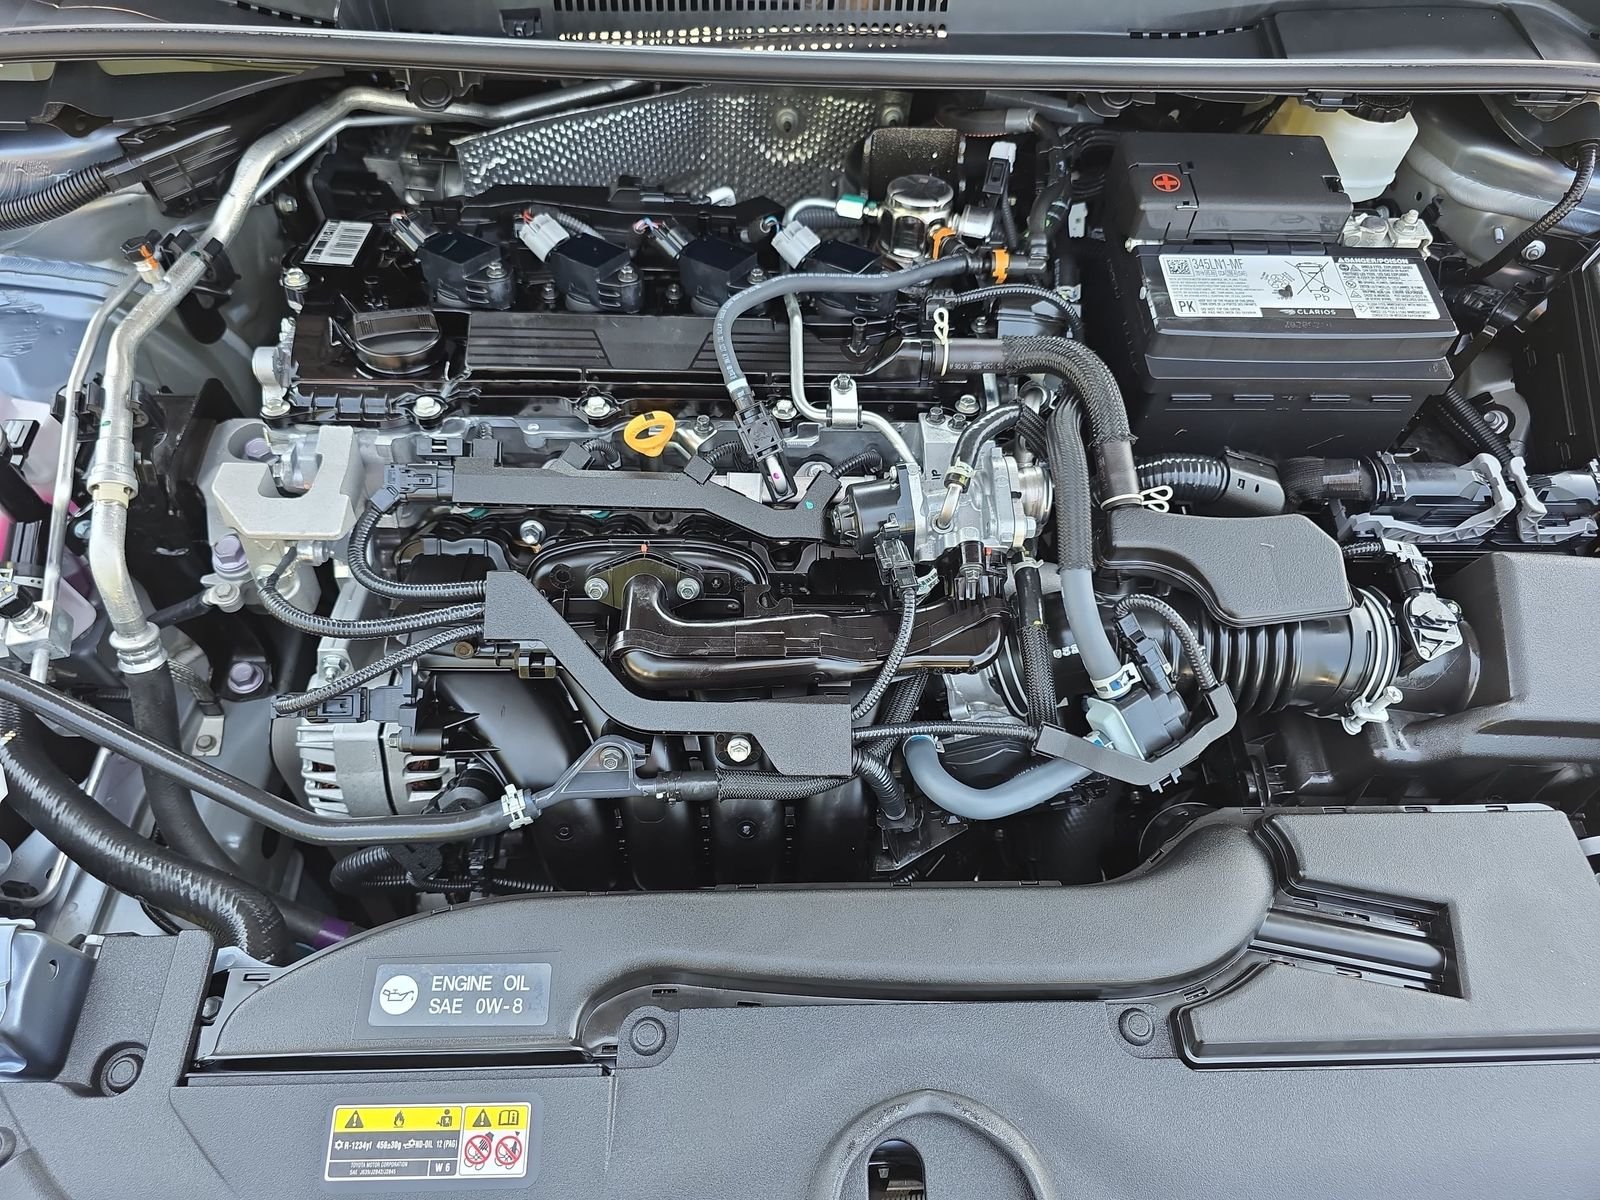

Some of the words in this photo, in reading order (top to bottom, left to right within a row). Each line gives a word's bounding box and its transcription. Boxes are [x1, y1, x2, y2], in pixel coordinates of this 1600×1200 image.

[1192, 258, 1244, 269] 345LN1-MF
[1178, 300, 1196, 313] PK
[431, 975, 493, 992] ENGINE
[503, 975, 531, 991] OIL
[428, 997, 463, 1014] SAE
[475, 997, 523, 1014] 0W-8
[343, 1141, 373, 1152] R-1234yf
[436, 1140, 443, 1149] 12
[443, 1139, 458, 1150] (PAG)
[435, 1163, 444, 1172] W
[445, 1162, 451, 1172] 6
